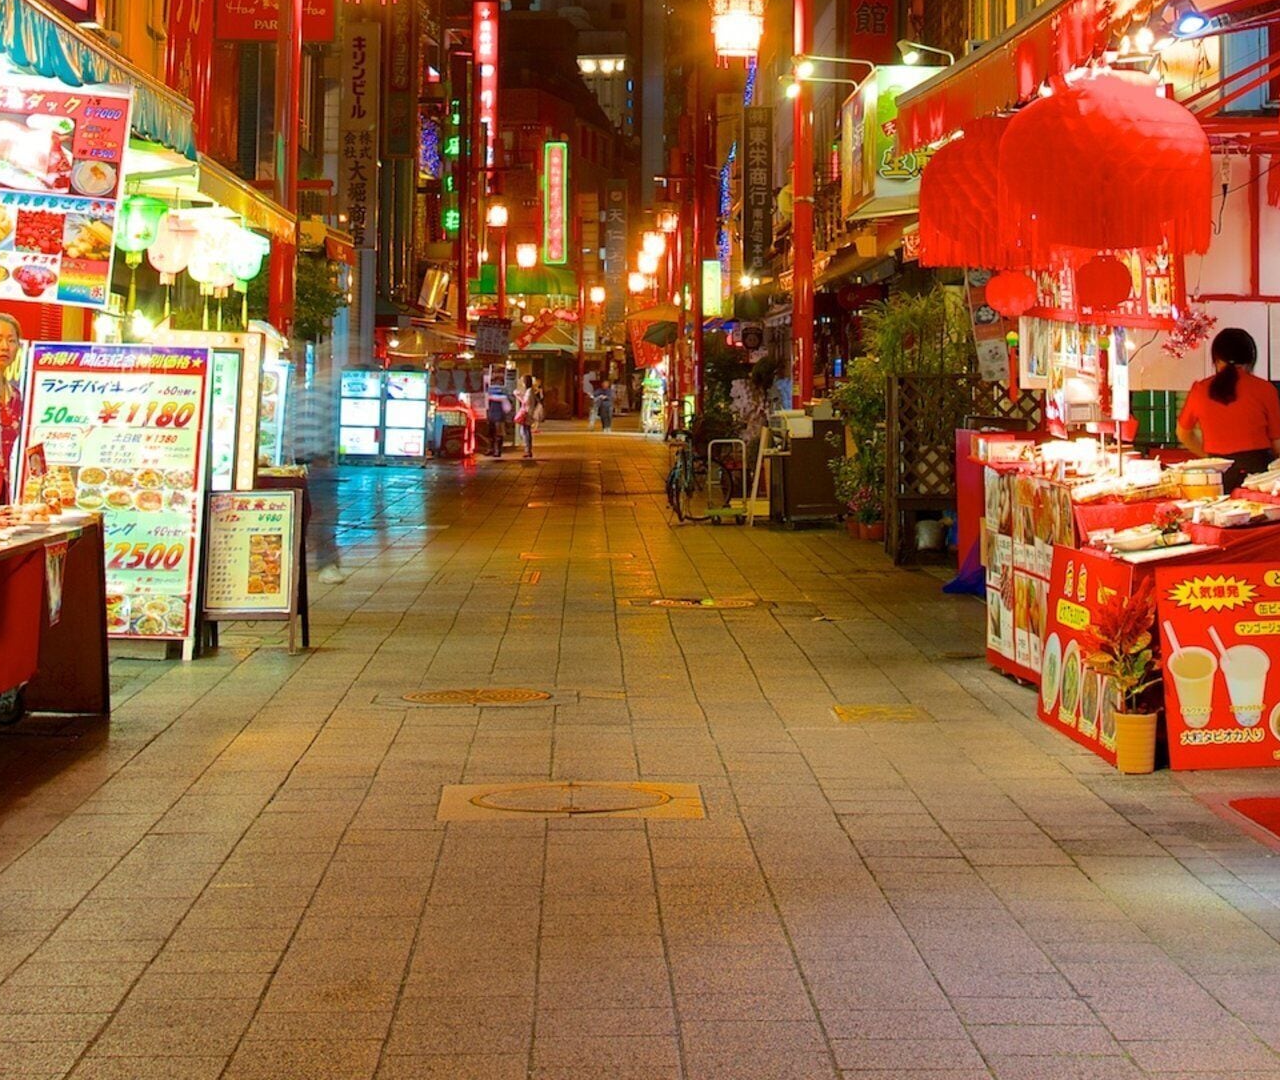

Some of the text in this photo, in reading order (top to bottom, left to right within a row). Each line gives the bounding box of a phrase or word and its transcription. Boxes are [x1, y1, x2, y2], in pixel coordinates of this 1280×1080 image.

[253, 19, 279, 30] PAR
[352, 35, 367, 120] キリンビール
[97, 400, 196, 428] ¥1180
[105, 542, 185, 570] 2500
